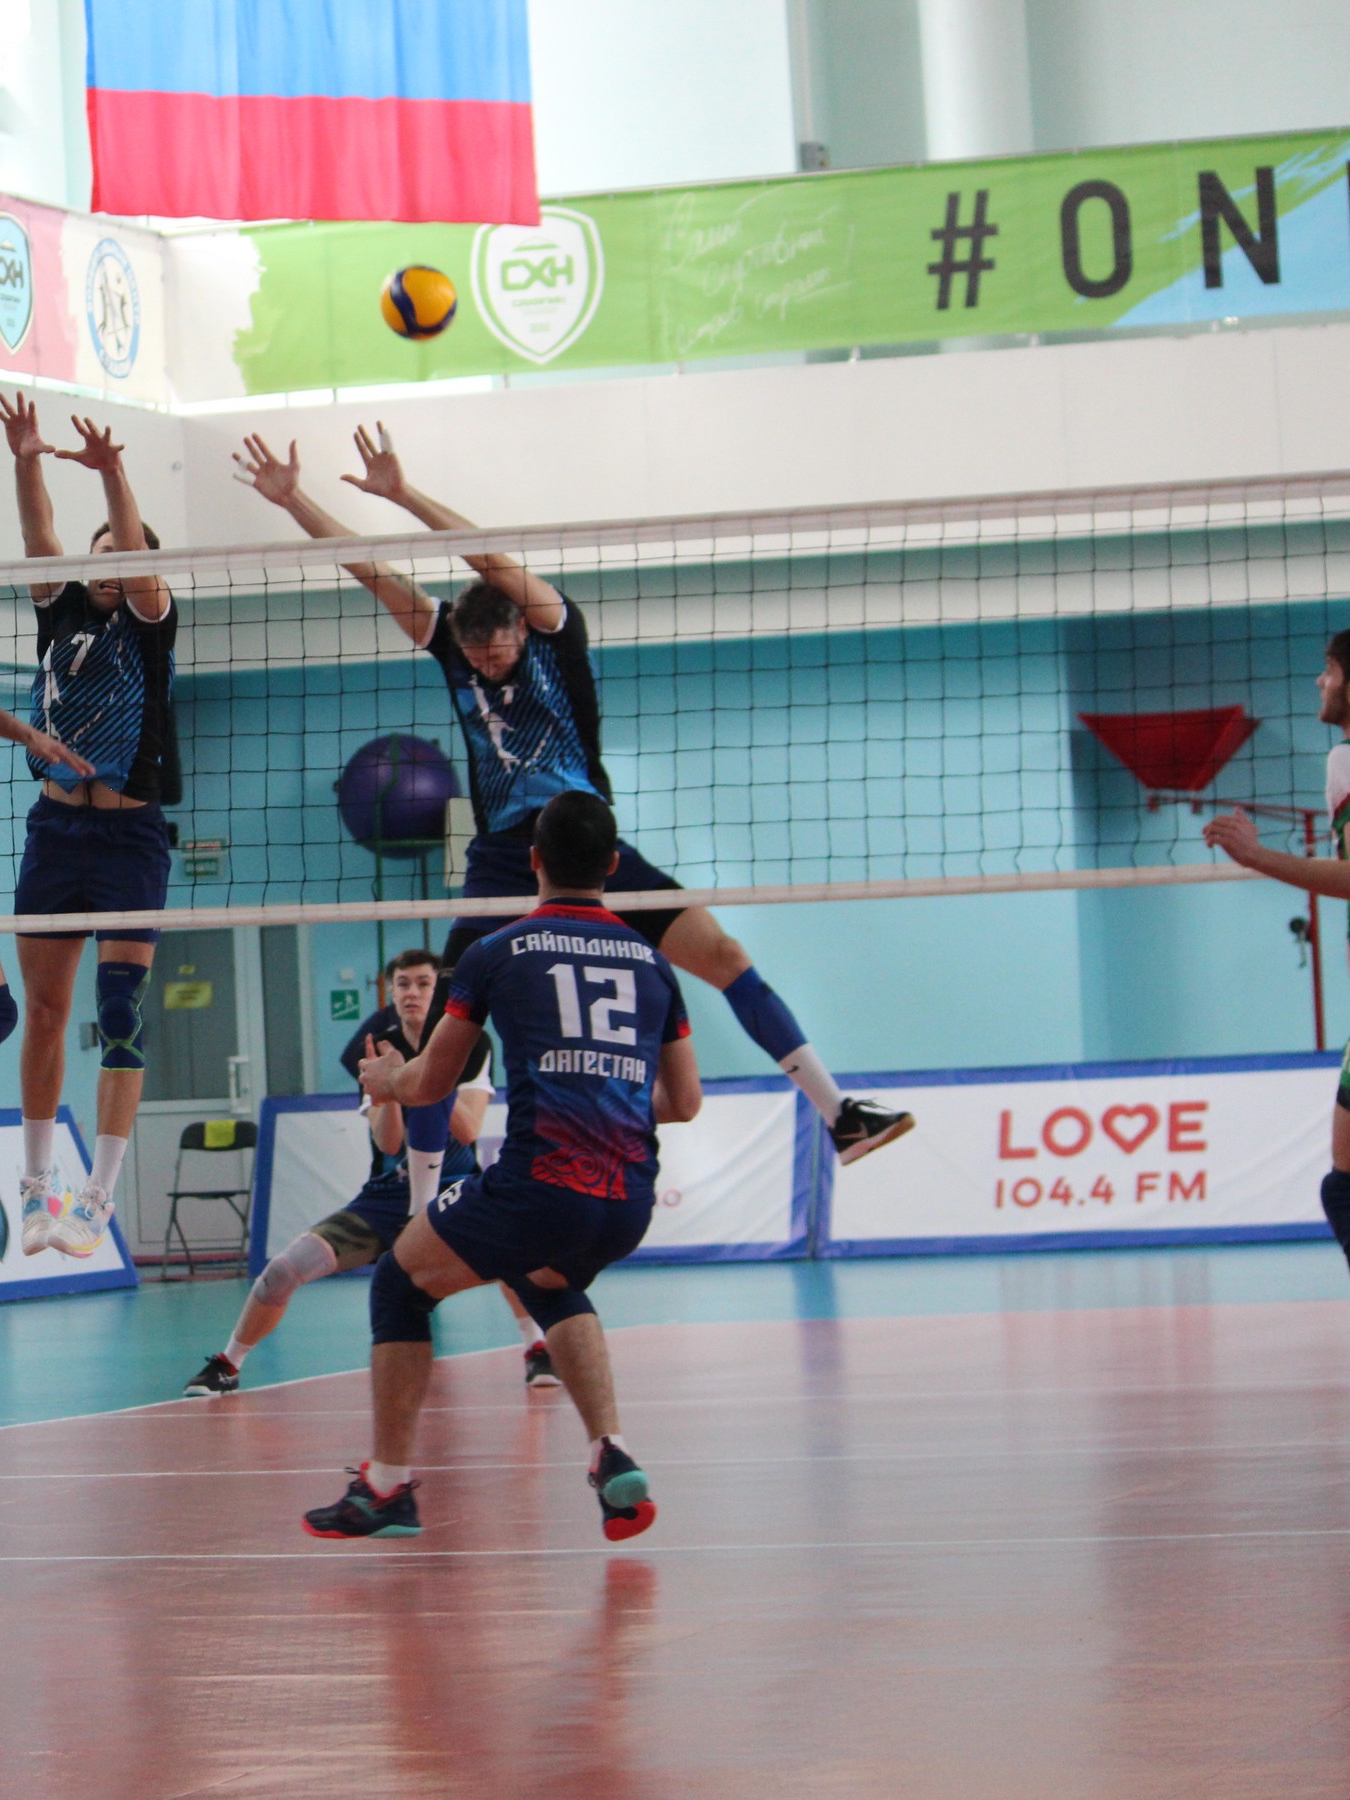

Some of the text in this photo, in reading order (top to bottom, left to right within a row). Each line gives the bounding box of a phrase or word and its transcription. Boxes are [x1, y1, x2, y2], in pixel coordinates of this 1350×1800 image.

[70, 632, 96, 676] 7
[545, 963, 637, 1046] 12
[538, 1049, 646, 1083] ДАГЕСТАН
[994, 1169, 1207, 1209] 104.4 FM
